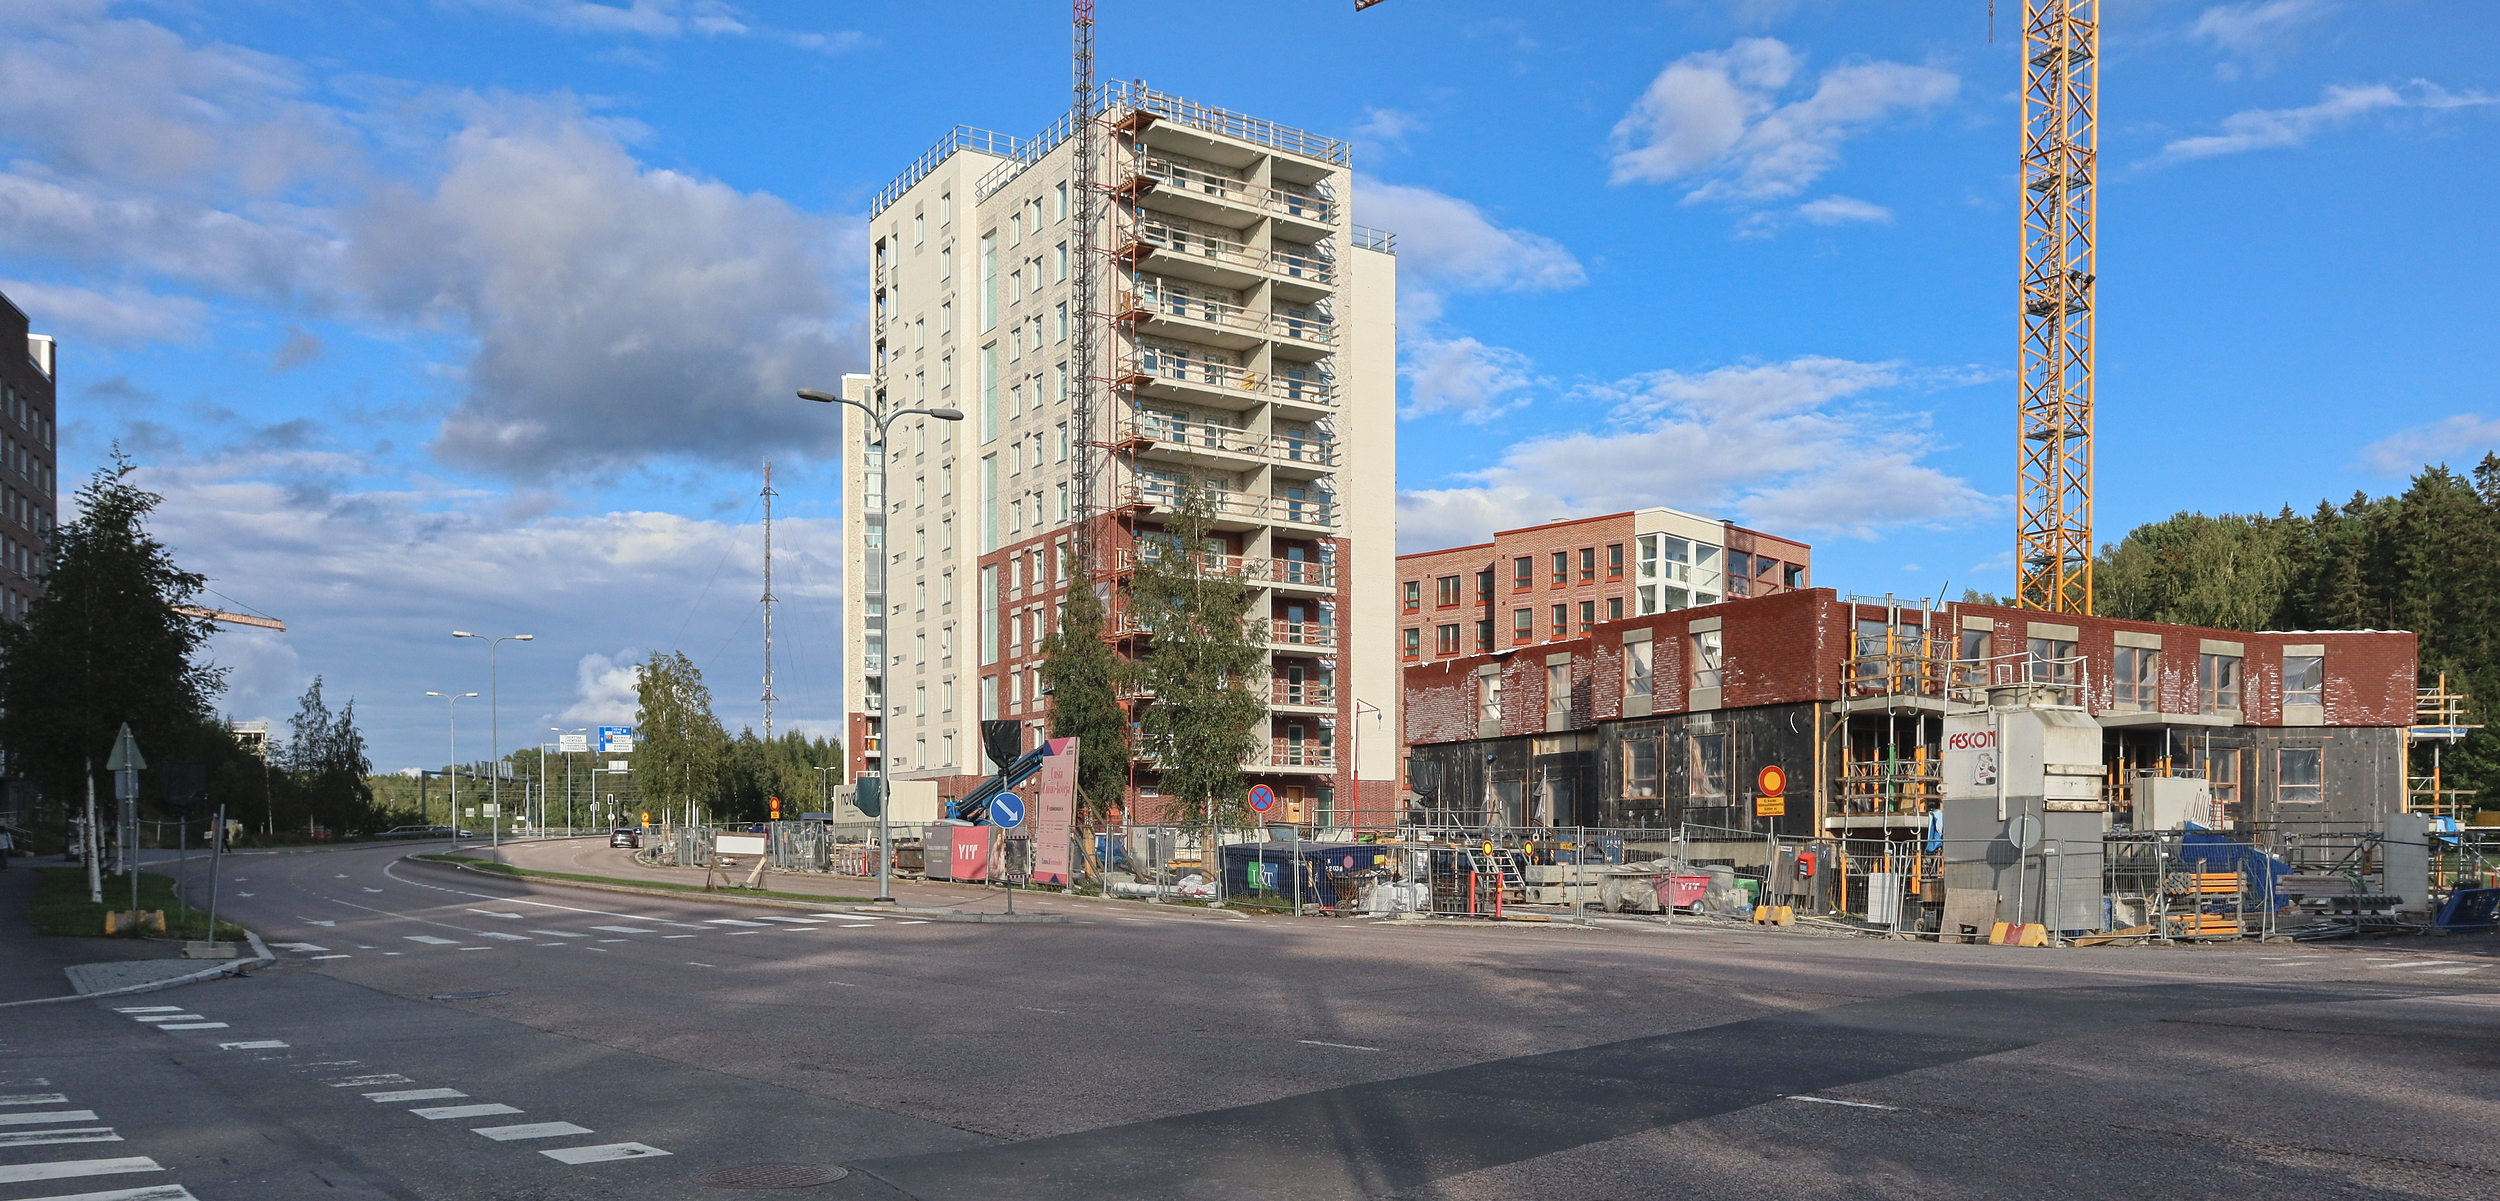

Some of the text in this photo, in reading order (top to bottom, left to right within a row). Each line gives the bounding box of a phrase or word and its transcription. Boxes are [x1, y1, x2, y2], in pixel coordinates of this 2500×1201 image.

[1949, 731, 1996, 750] FESCON
[958, 843, 978, 860] YIT
[1252, 864, 1273, 887] L&T
[1681, 882, 1700, 891] YIT
